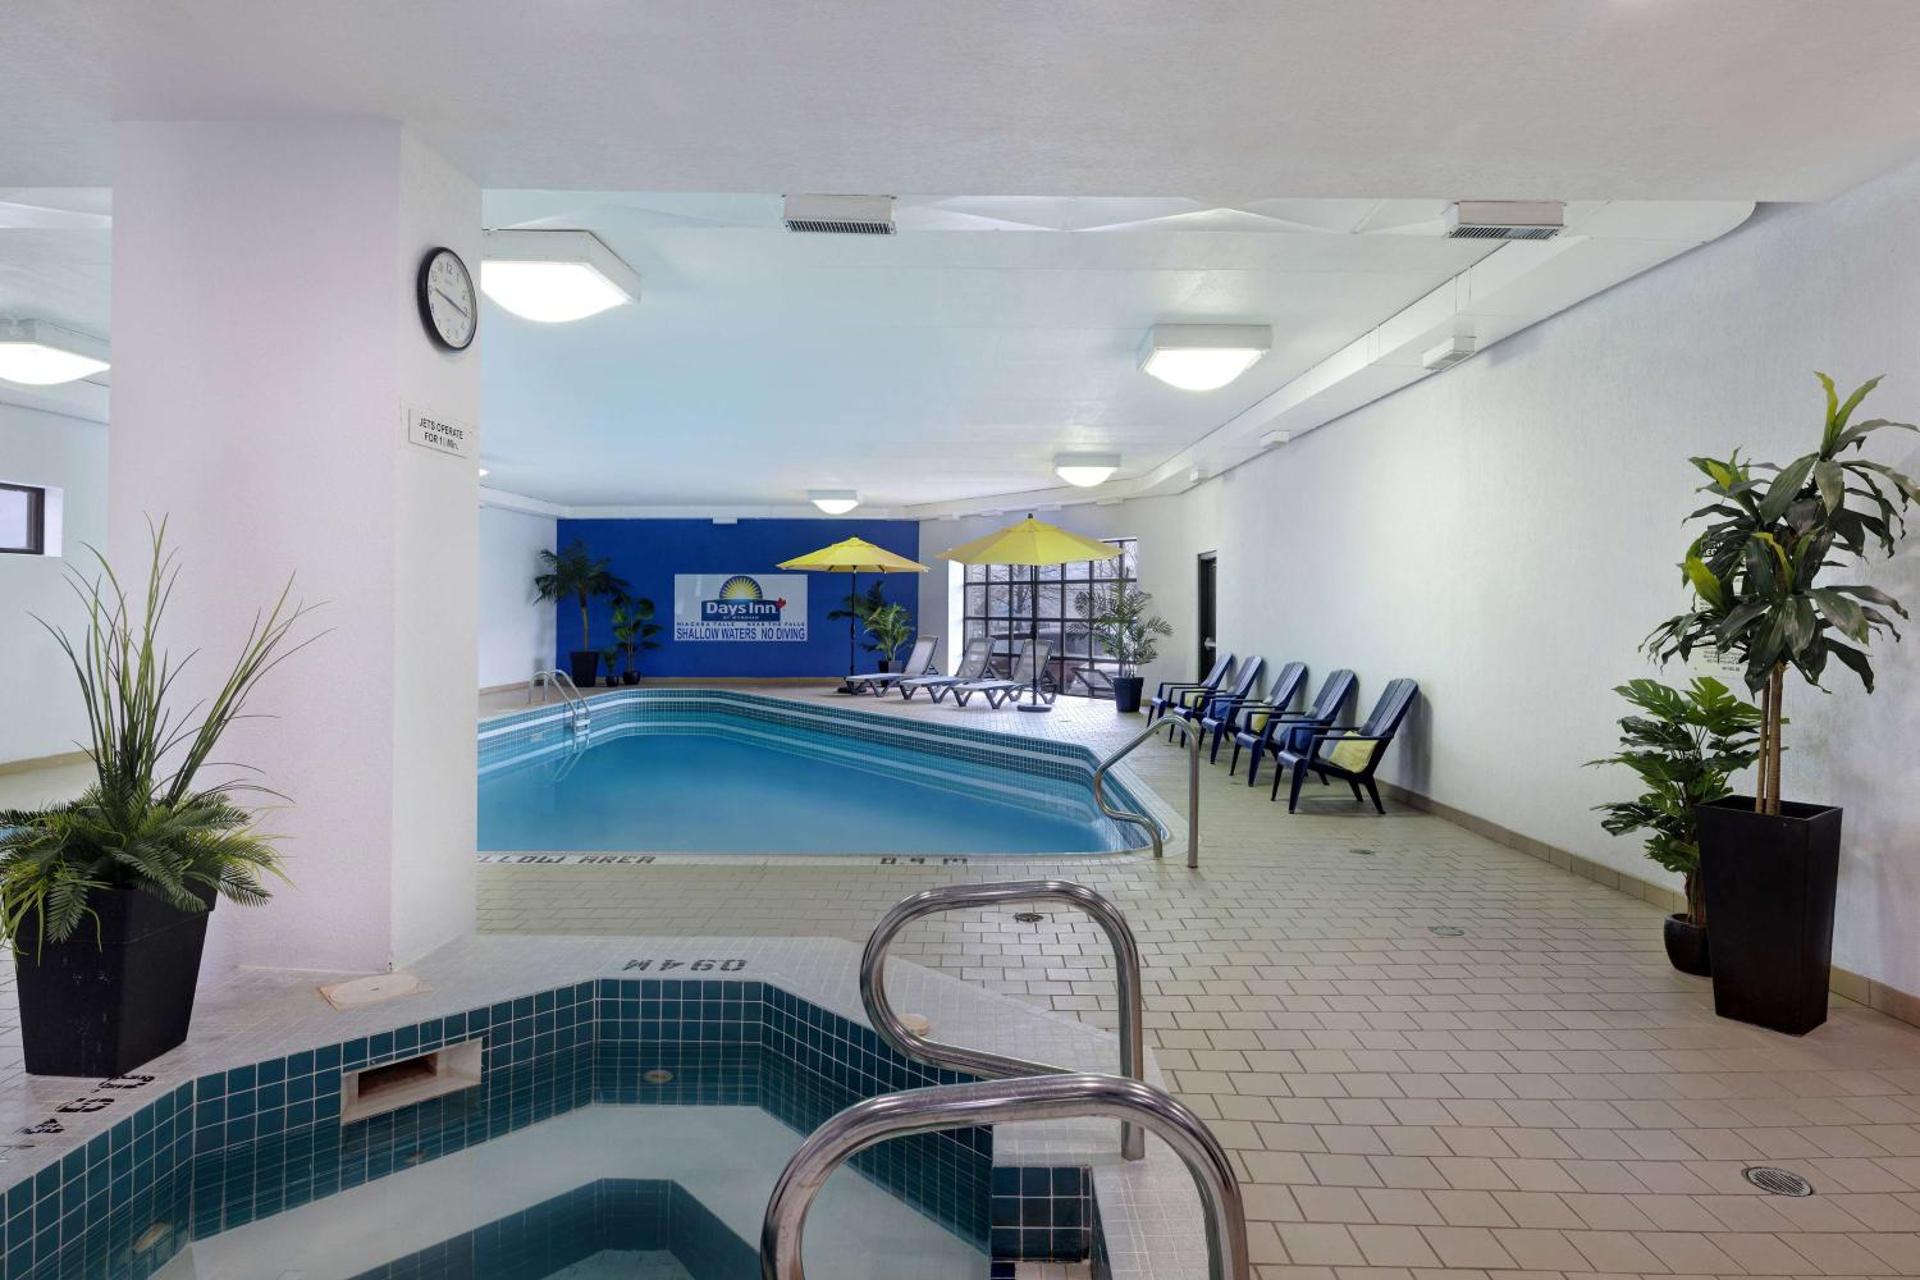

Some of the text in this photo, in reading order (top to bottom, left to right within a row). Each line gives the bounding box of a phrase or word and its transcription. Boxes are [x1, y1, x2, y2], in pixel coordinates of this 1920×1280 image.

[419, 418, 464, 440] JETS OPERATE
[424, 432, 439, 444] FOR
[706, 602, 777, 615] Days Inn
[676, 627, 805, 640] SHALLOW WATERS NO DIVING
[475, 855, 657, 864] LLOW AREA
